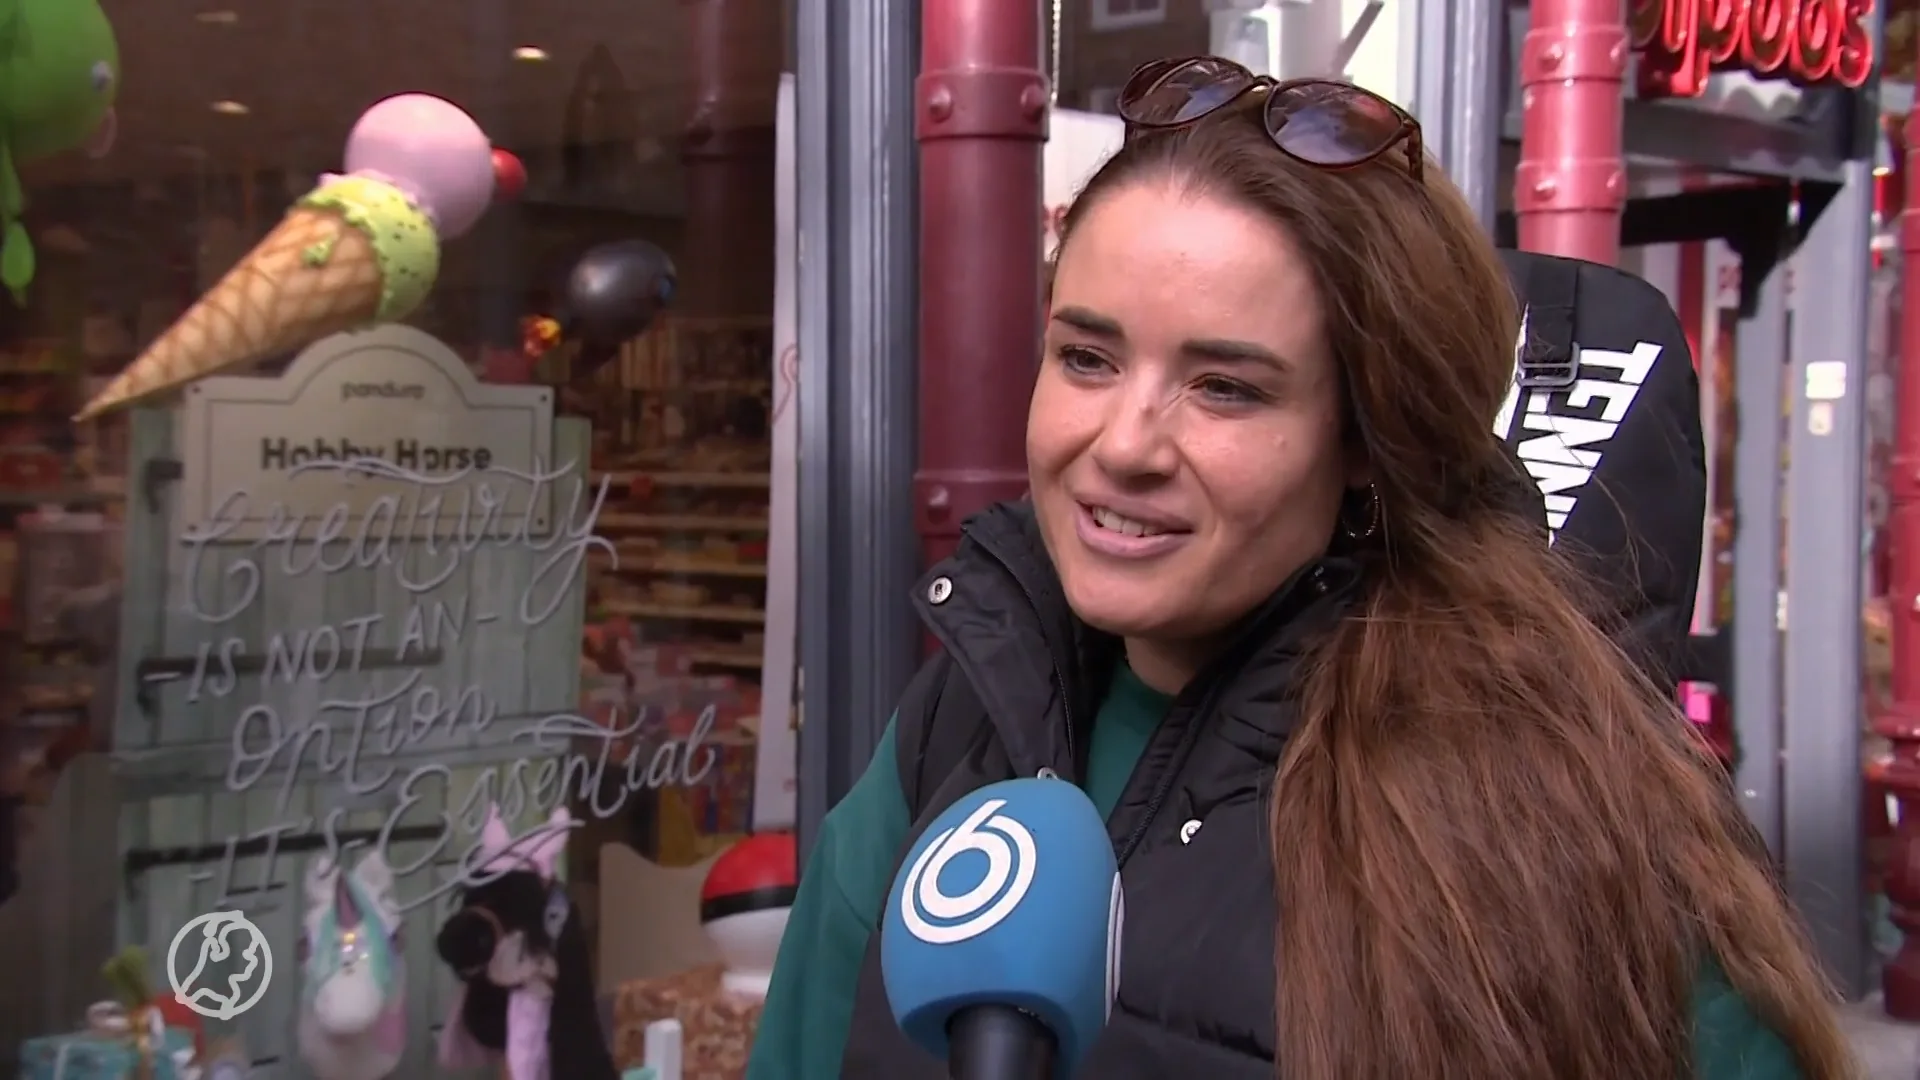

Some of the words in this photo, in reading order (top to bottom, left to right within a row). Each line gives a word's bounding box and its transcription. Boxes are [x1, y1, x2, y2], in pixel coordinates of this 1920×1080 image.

[260, 436, 387, 479] Hobby
[395, 438, 493, 471] Horse
[261, 613, 384, 686] NOT
